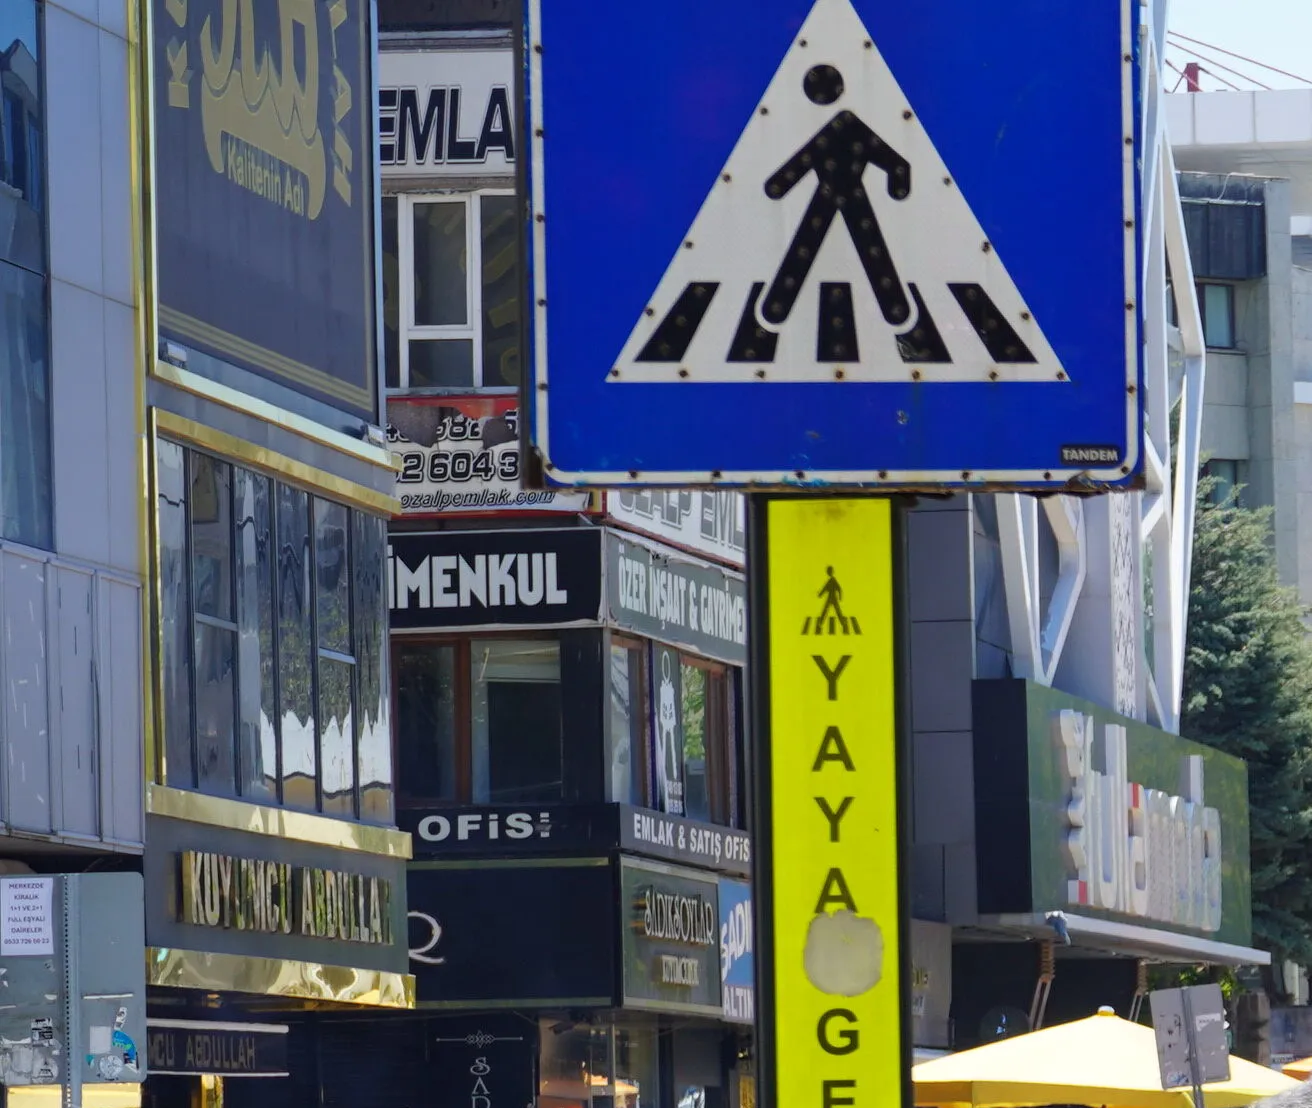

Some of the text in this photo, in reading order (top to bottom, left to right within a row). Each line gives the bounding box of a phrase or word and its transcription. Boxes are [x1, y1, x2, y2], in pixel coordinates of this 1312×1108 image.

[1062, 448, 1118, 461] TANDEM
[810, 653, 857, 914] YAYA
[634, 813, 675, 847] EMLAK
[678, 825, 687, 850] &
[690, 827, 721, 860] SATIŞ
[187, 850, 293, 935] KUYUMCU
[300, 866, 394, 946] ABDULLAH
[185, 1033, 256, 1070] ABDULLAH
